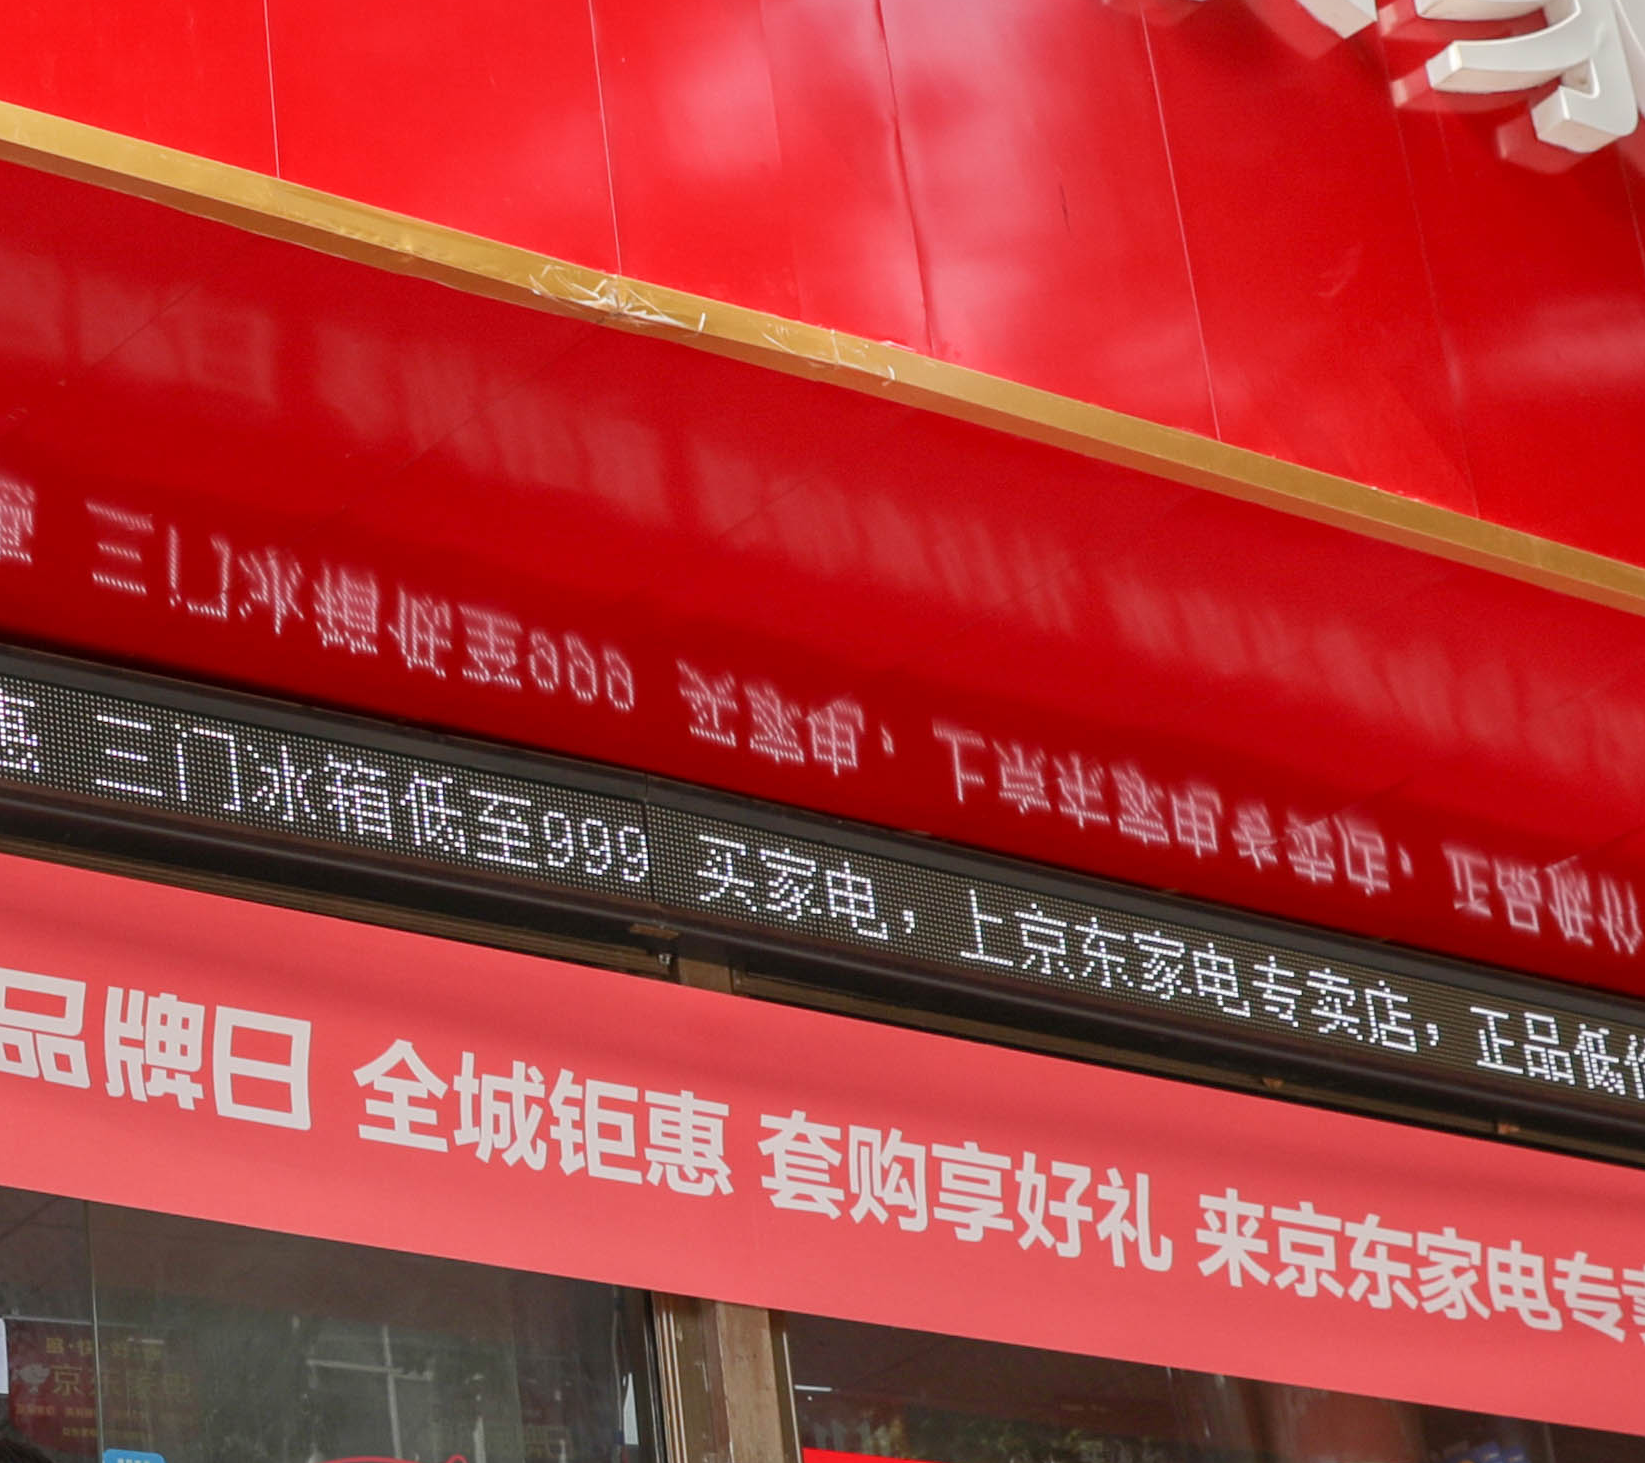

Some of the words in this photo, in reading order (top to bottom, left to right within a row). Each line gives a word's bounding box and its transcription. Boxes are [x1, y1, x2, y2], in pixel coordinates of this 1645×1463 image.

[93, 711, 651, 885] 三门冰箱低至999
[352, 1037, 734, 1200] 全城钜惠
[756, 1107, 1175, 1276] 套购享好礼
